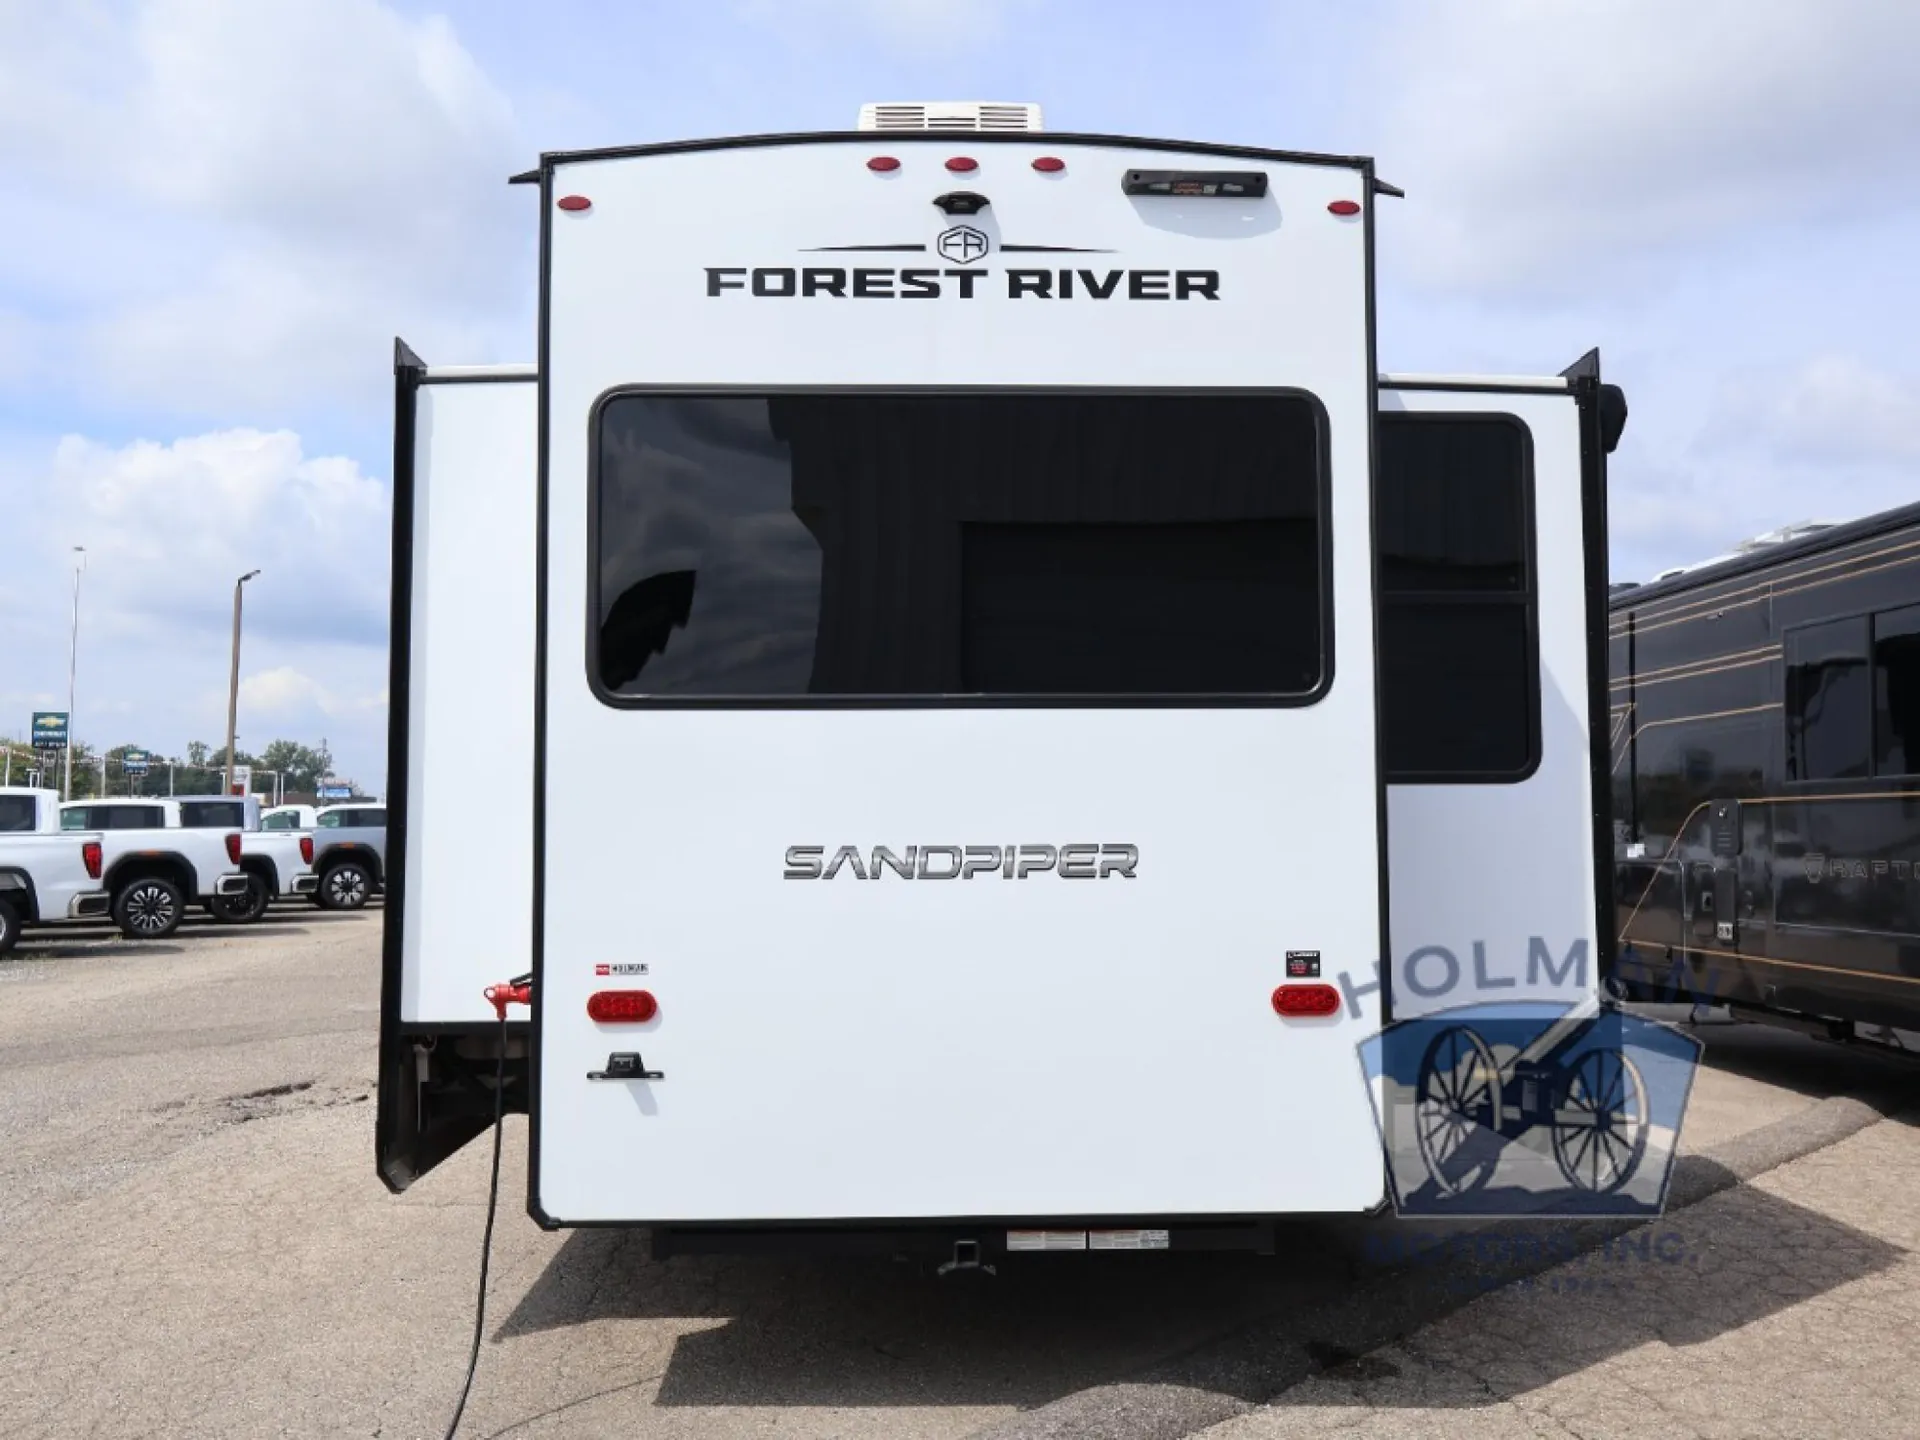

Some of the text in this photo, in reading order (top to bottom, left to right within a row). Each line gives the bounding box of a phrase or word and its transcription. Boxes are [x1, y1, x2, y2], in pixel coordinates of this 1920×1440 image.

[943, 231, 983, 259] FR
[704, 267, 1221, 300] FOREST RIVER
[783, 843, 1139, 880] SANDPIPER
